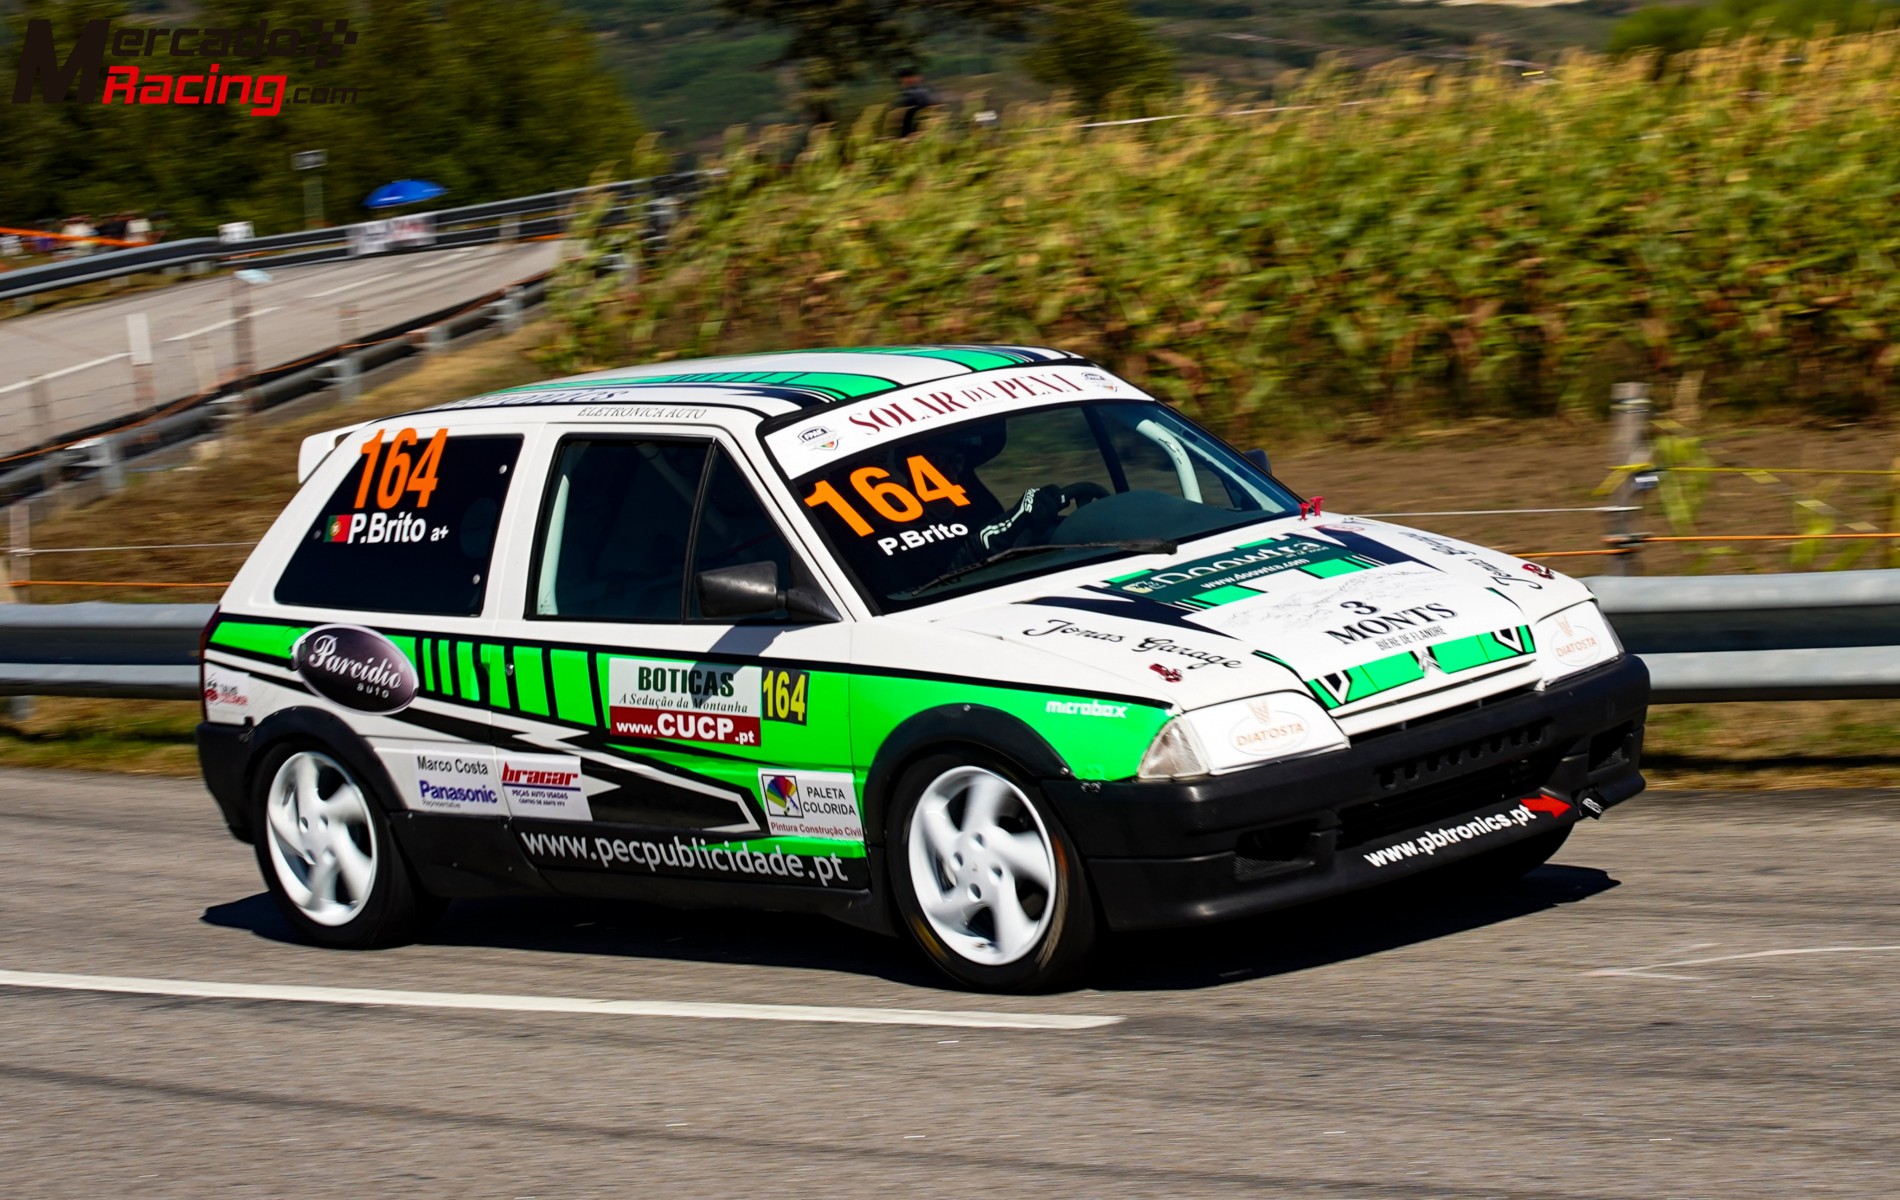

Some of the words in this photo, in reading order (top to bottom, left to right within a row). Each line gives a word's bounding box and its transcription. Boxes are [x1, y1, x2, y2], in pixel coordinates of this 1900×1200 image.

[664, 408, 707, 420] AUTO
[849, 391, 968, 436] SOLAR
[962, 384, 999, 402] DA
[354, 428, 449, 509] 164
[803, 454, 971, 537] 164
[347, 511, 426, 544] P.Brito
[877, 523, 969, 556] P.Brito
[1340, 600, 1380, 615] 3
[1322, 602, 1458, 645] MONTS
[1023, 619, 1125, 643] Jonas
[1132, 637, 1244, 670] Garage
[1556, 636, 1598, 658] DIATOSTA
[356, 682, 390, 699] auto
[619, 693, 628, 704] A
[629, 693, 674, 709] Sedução
[677, 697, 689, 708] da
[693, 698, 748, 713] Montanha
[638, 666, 734, 697] BOTICAS
[763, 671, 805, 722] 164
[616, 713, 755, 745] www.CUCP.pt
[1236, 721, 1305, 747] DIATOSTA
[417, 755, 451, 773] Marco
[455, 758, 488, 775] Costa
[502, 762, 578, 786] bracar
[419, 780, 498, 804] Panasonic
[807, 787, 845, 800] PALETA
[803, 802, 856, 816] COLORIDA
[770, 821, 798, 833] Pintura
[799, 823, 844, 837] Construção
[844, 826, 862, 837] Civil
[1364, 804, 1537, 867] www.pbtronics.pt
[521, 832, 848, 886] www.pecpublicidade.pt
